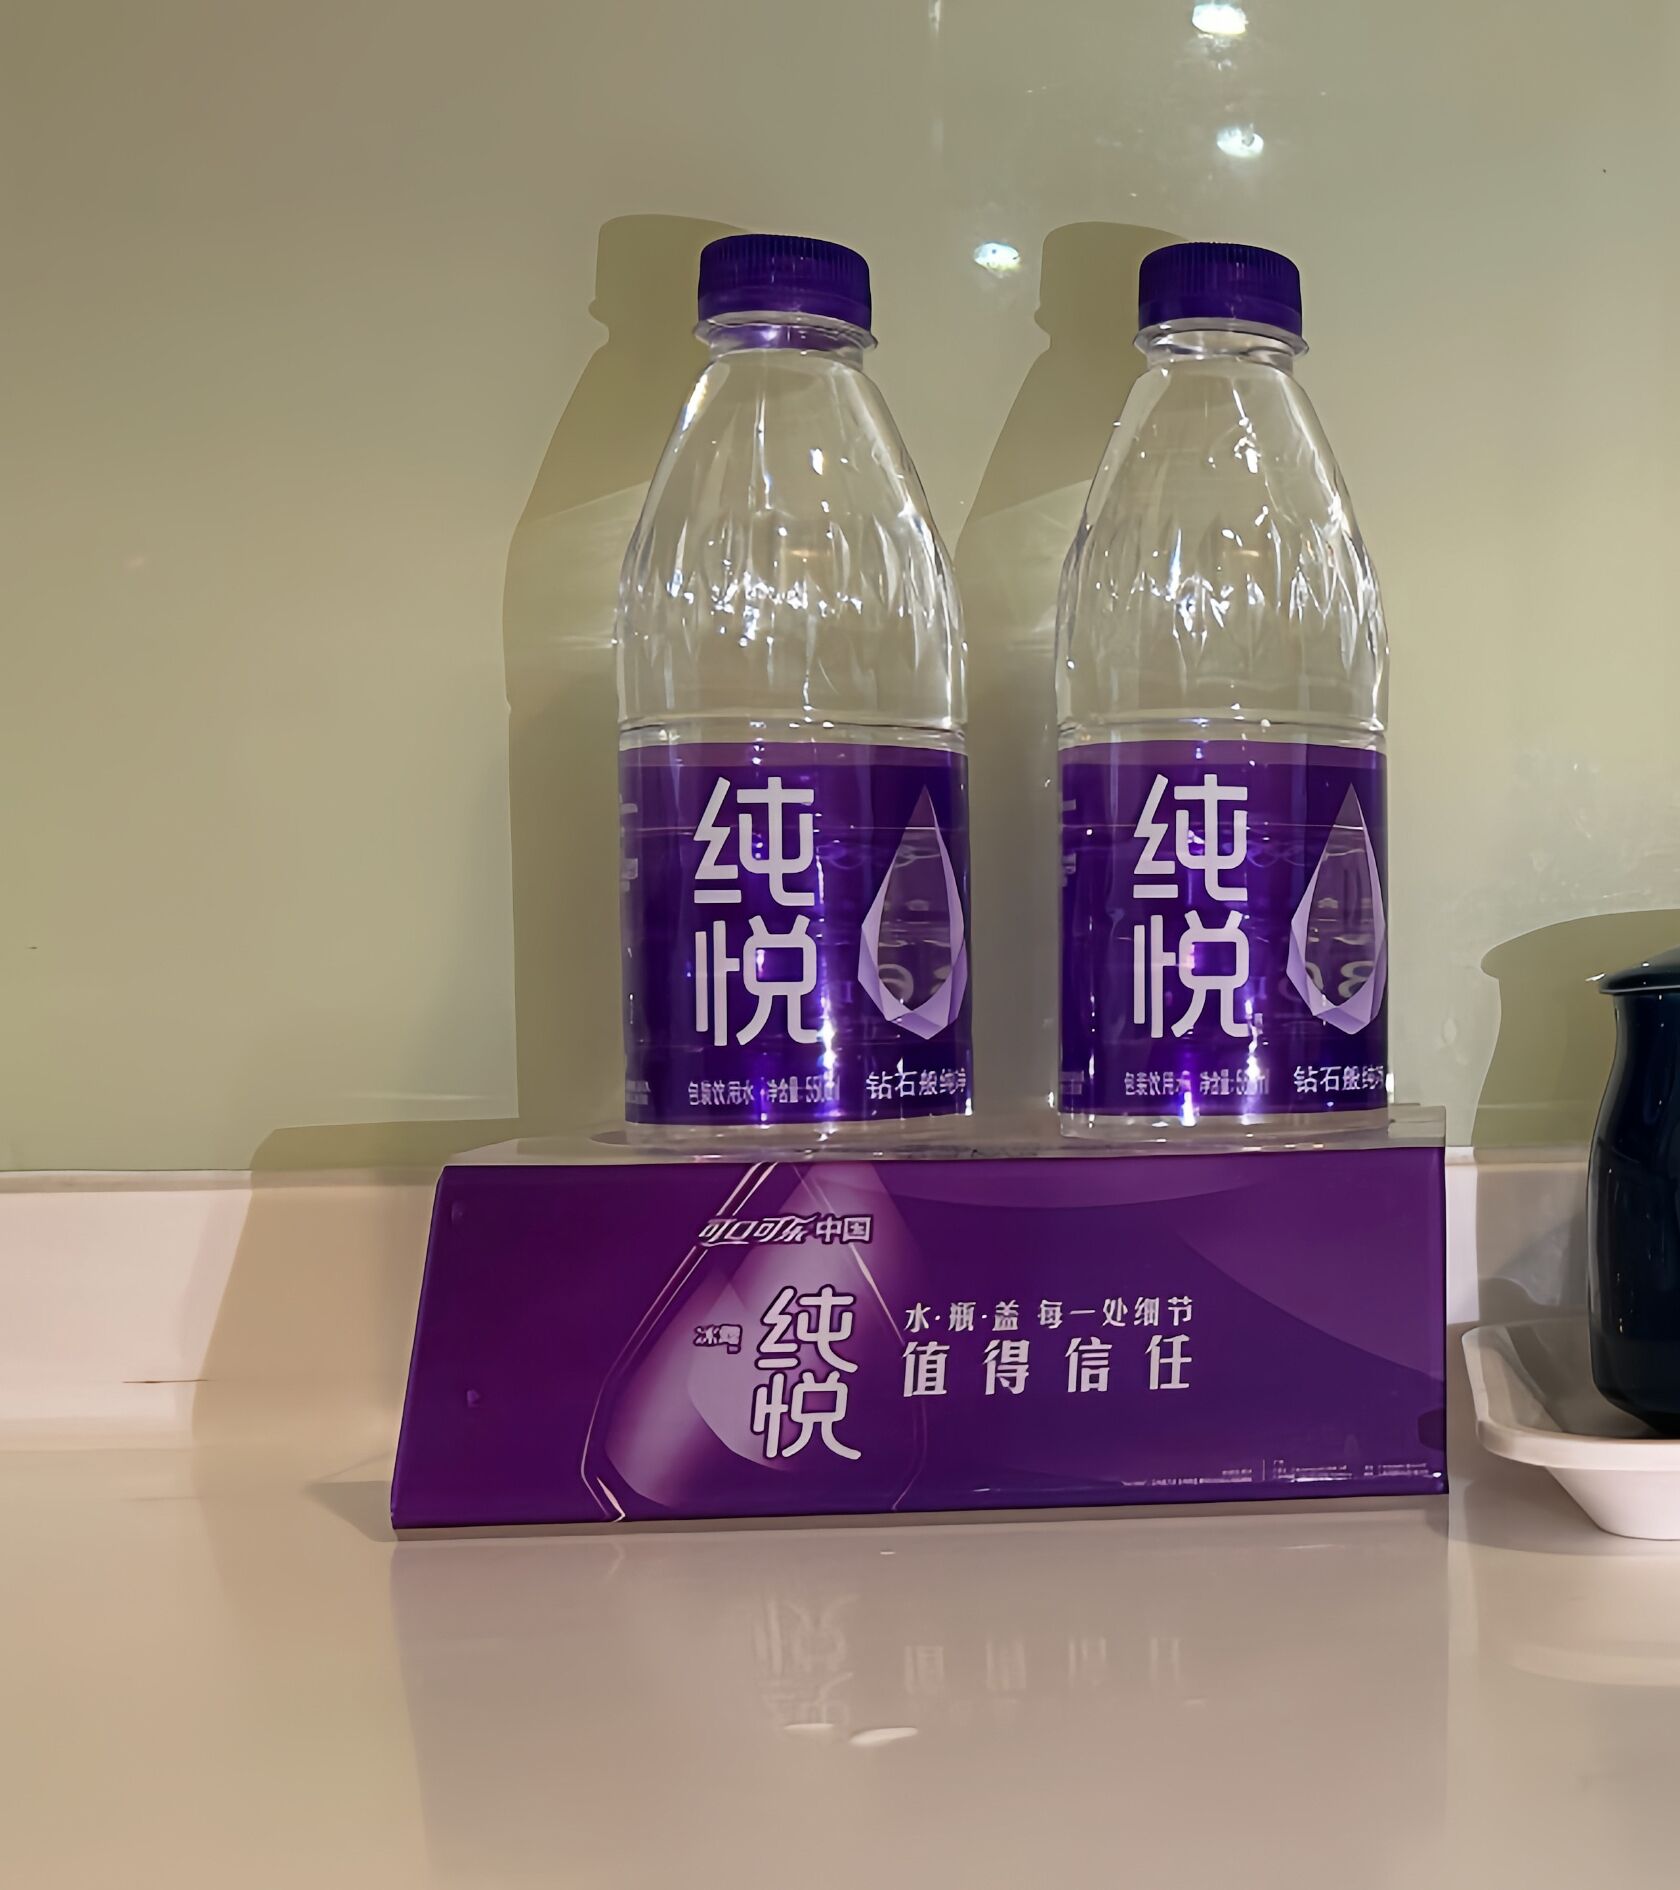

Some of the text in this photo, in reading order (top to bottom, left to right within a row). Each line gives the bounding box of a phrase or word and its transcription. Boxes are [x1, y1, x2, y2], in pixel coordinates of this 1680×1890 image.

[693, 776, 820, 1046] 纯悦
[1133, 773, 1251, 1038] 纯悦
[866, 1067, 966, 1099] 钻石般纯净
[752, 1285, 863, 1461] 纯悦
[902, 1333, 1193, 1398] 值得信任
